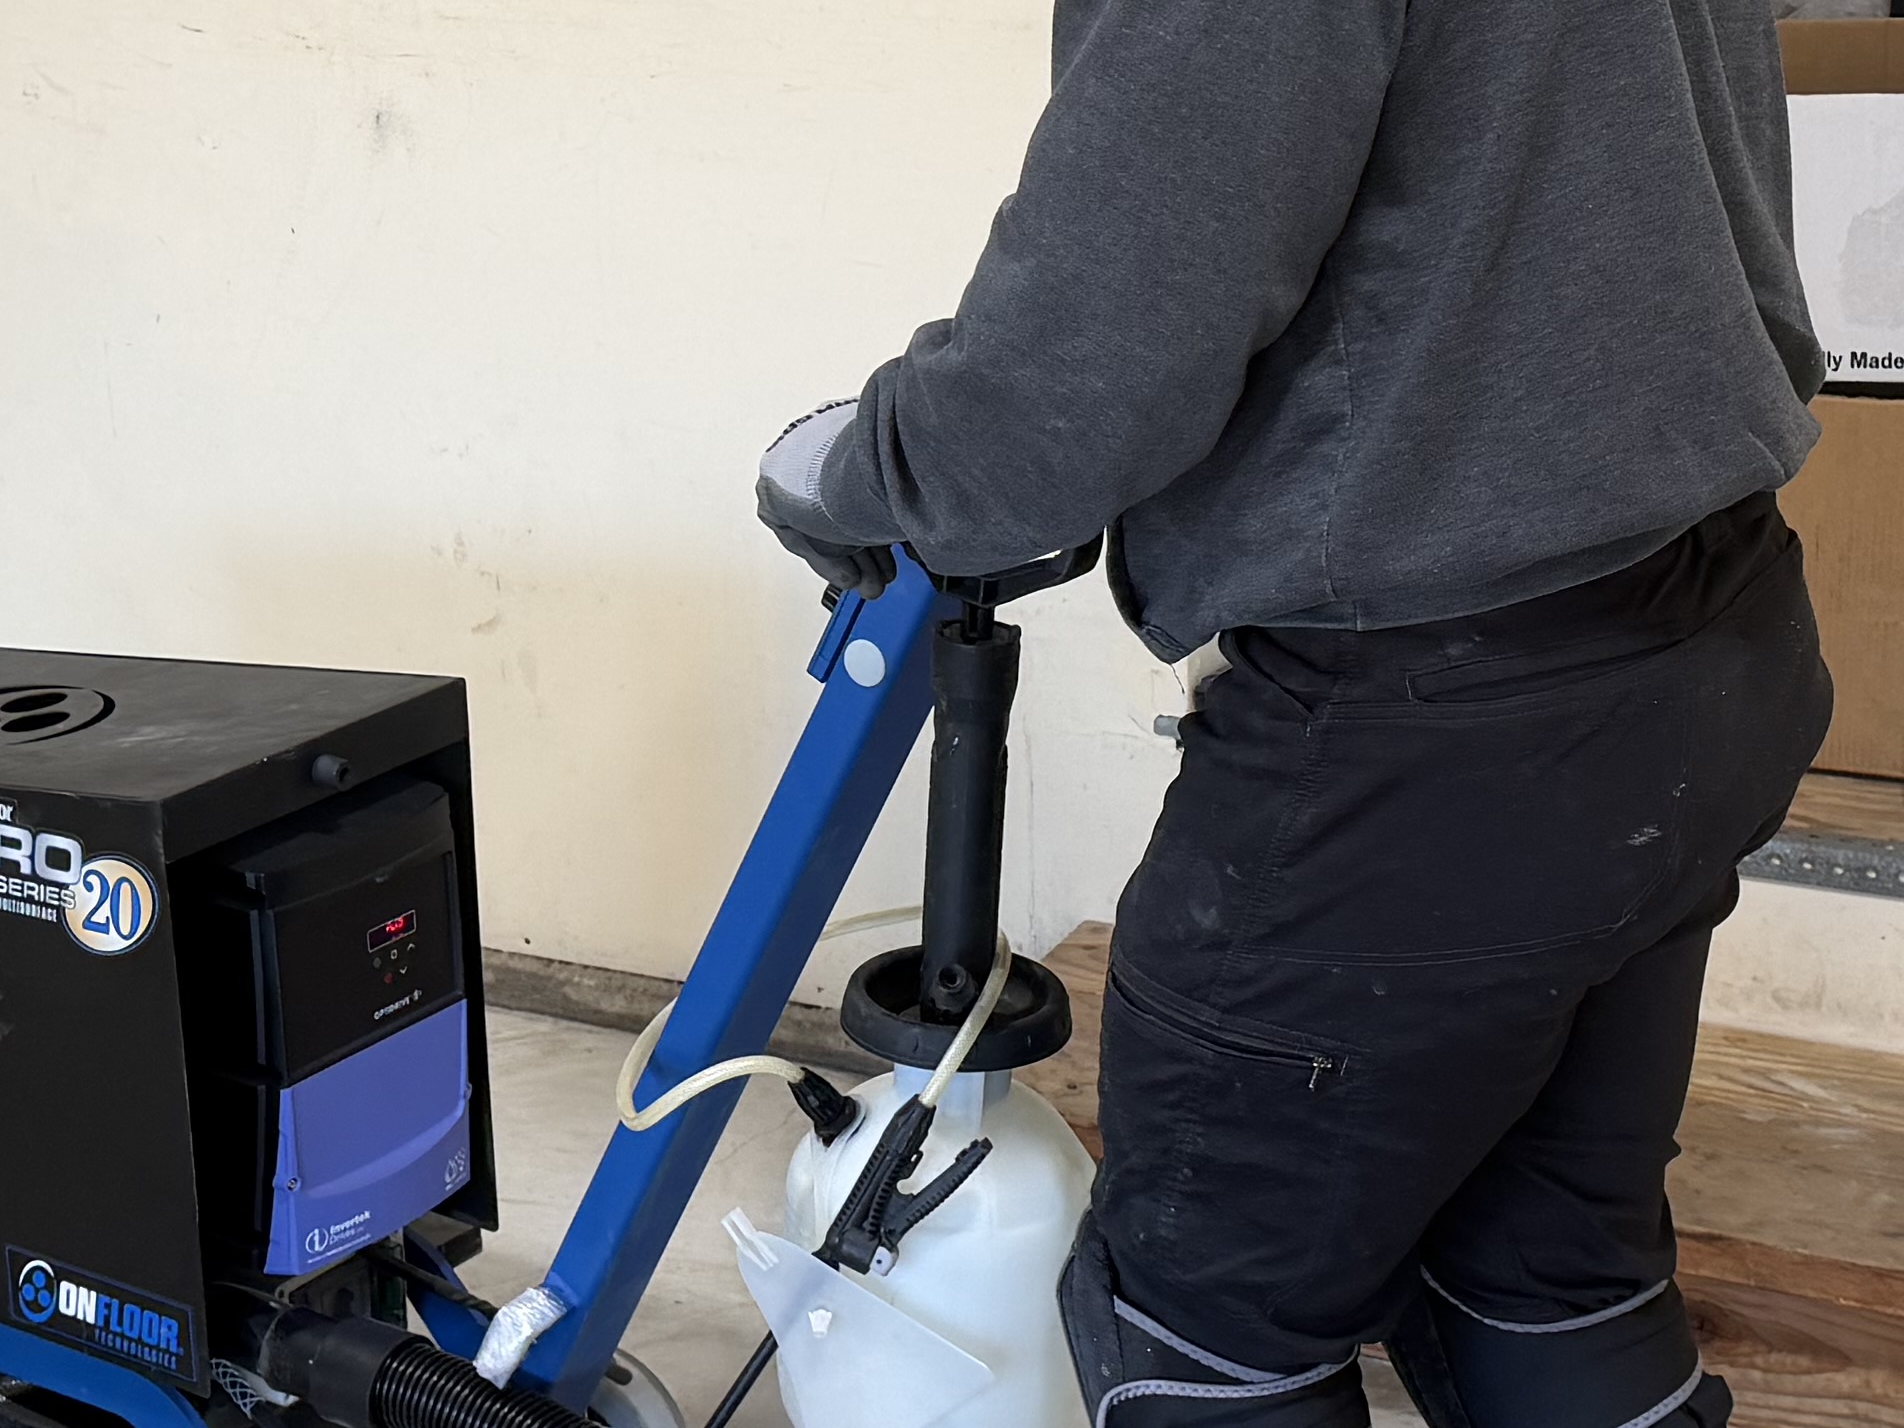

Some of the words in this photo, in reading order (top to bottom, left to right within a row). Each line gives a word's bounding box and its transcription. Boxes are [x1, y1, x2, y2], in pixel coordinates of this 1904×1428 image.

[1850, 351, 1904, 370] Made
[82, 868, 142, 941] 20
[330, 1210, 371, 1235] Invertek
[58, 1280, 179, 1355] ONFLOOR
